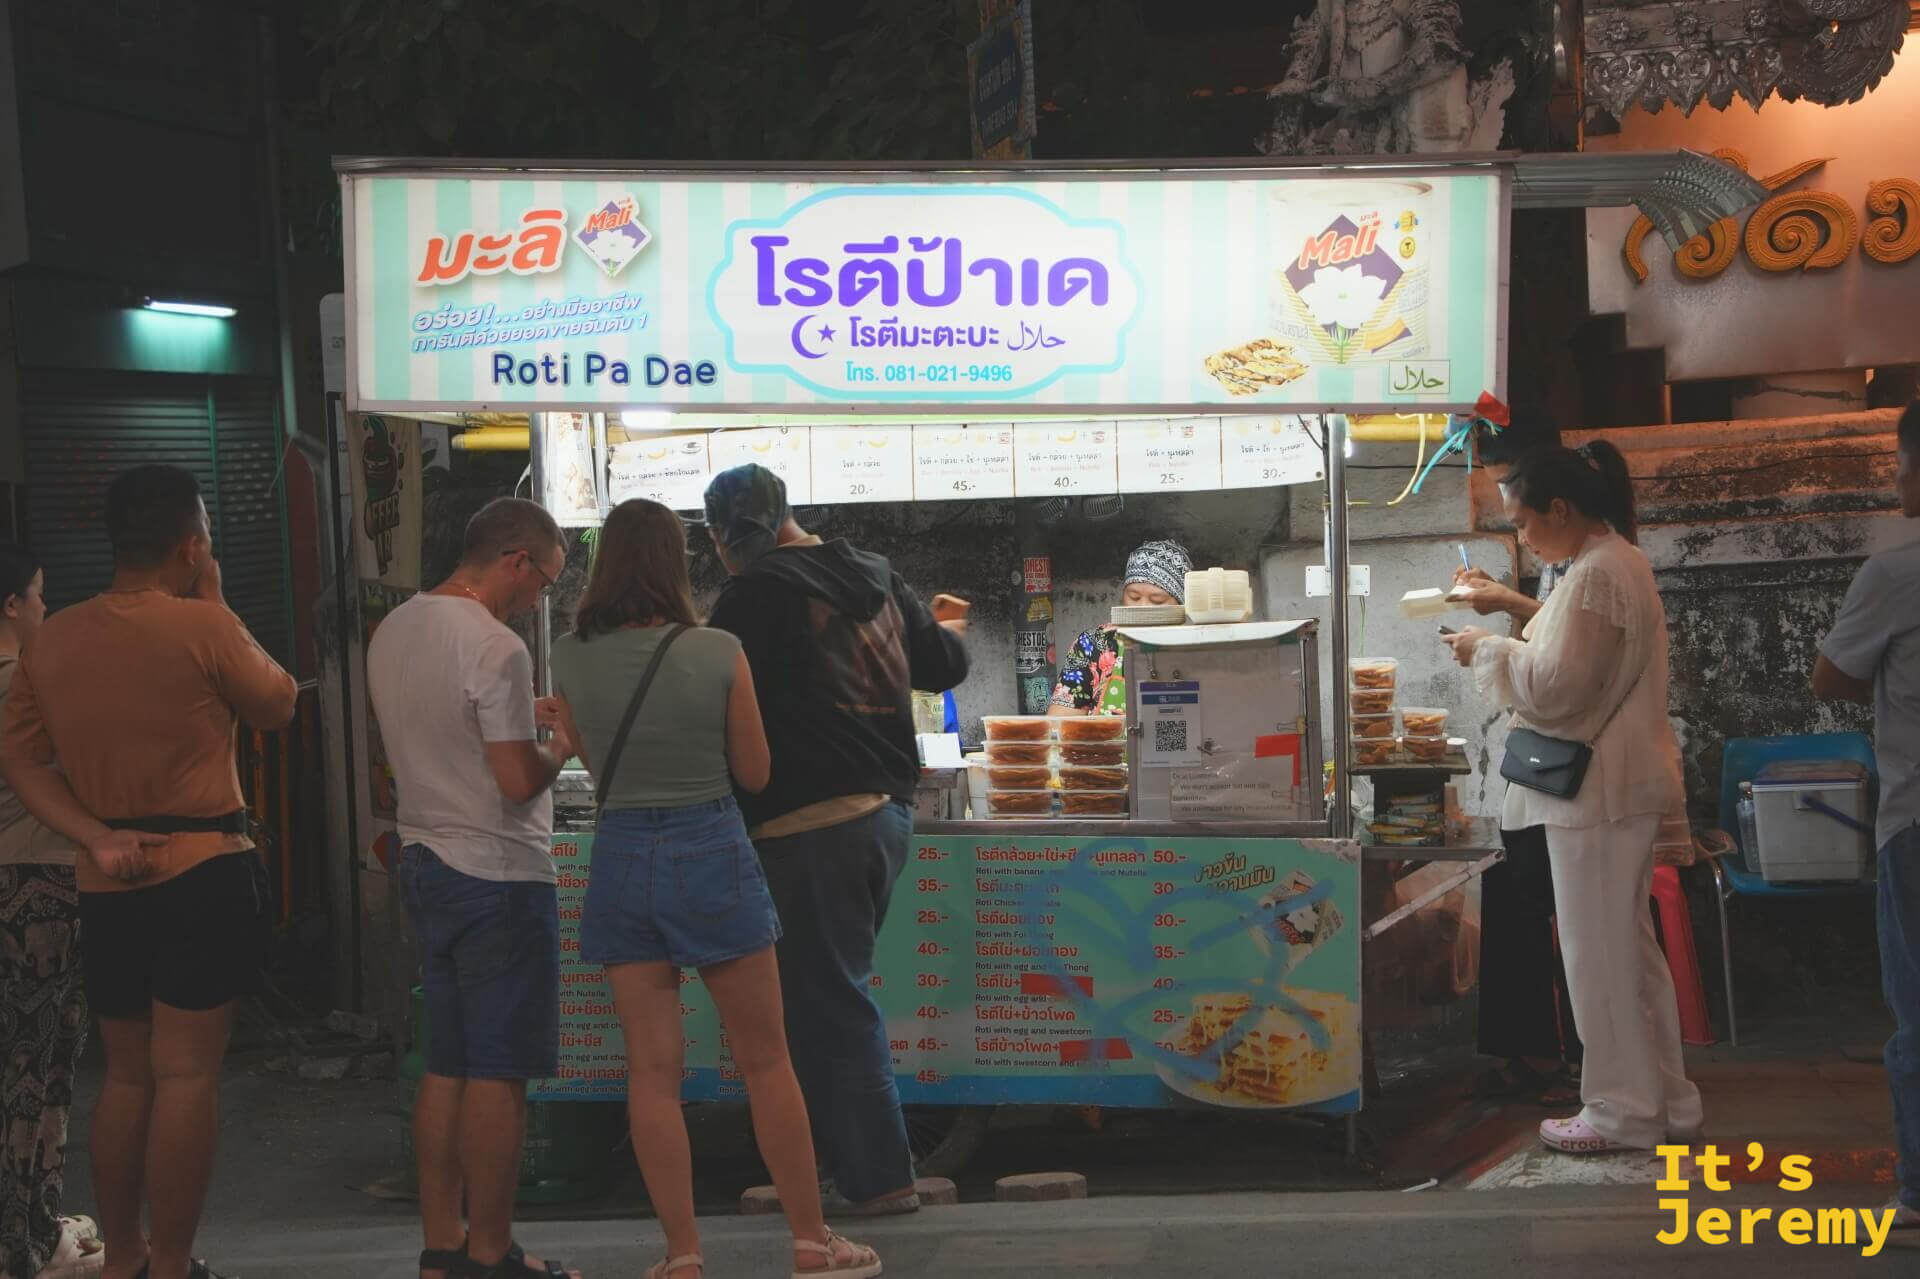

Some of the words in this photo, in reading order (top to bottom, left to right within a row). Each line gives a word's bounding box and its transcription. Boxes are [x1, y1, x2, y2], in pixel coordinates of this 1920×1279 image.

[586, 204, 633, 233] Mali
[417, 209, 563, 282] มะลิ
[1299, 220, 1381, 270] Mali
[751, 235, 1109, 307] โรตีป้าเด
[849, 316, 999, 348] โรตีมะตะบะ
[1007, 321, 1066, 351] حلال
[492, 353, 570, 385] Roti
[585, 354, 630, 385] Pa
[646, 357, 716, 386] Dae
[846, 361, 880, 382] โทร.
[885, 365, 1012, 382] 081-021-9496
[1394, 366, 1444, 391] حلال
[1160, 473, 1184, 484] 25.-
[1262, 469, 1286, 479] 30.-
[952, 480, 976, 491] 45.-
[1054, 476, 1078, 488] 40.-
[850, 484, 873, 495] 20.-
[918, 848, 949, 860] 25.-
[1153, 851, 1186, 863] 50.-
[976, 867, 991, 875] Roti
[994, 867, 1011, 875] with
[918, 880, 949, 892] 35.-
[976, 899, 991, 907] Roti
[918, 911, 949, 924] 25.-
[1154, 914, 1186, 927] 30.-
[976, 930, 991, 938] Roti
[994, 930, 1012, 938] with
[917, 943, 949, 955] 40.-
[1154, 946, 1186, 959] 35.-
[976, 962, 991, 970] Roti
[994, 962, 1012, 970] with
[1014, 963, 1028, 971] egg
[1064, 963, 1089, 972] Thong
[918, 975, 949, 987] 30.-
[976, 994, 991, 1002] Roti
[994, 994, 1011, 1002] with
[1014, 995, 1028, 1004] egg
[1031, 994, 1047, 1002] and
[917, 1006, 949, 1019] 40.-
[1153, 1010, 1185, 1023] 25.-
[975, 1026, 991, 1034] Roti
[994, 1026, 1011, 1034] with
[1014, 1027, 1028, 1036] egg
[1031, 1027, 1047, 1035] and
[1049, 1028, 1092, 1036] sweetcorn
[917, 1038, 949, 1050] 45.-
[975, 1058, 991, 1066] Roti
[994, 1058, 1011, 1066] with
[1014, 1059, 1057, 1067] sweetcorn
[917, 1070, 948, 1083] 45.-
[1561, 1139, 1607, 1150] crocs
